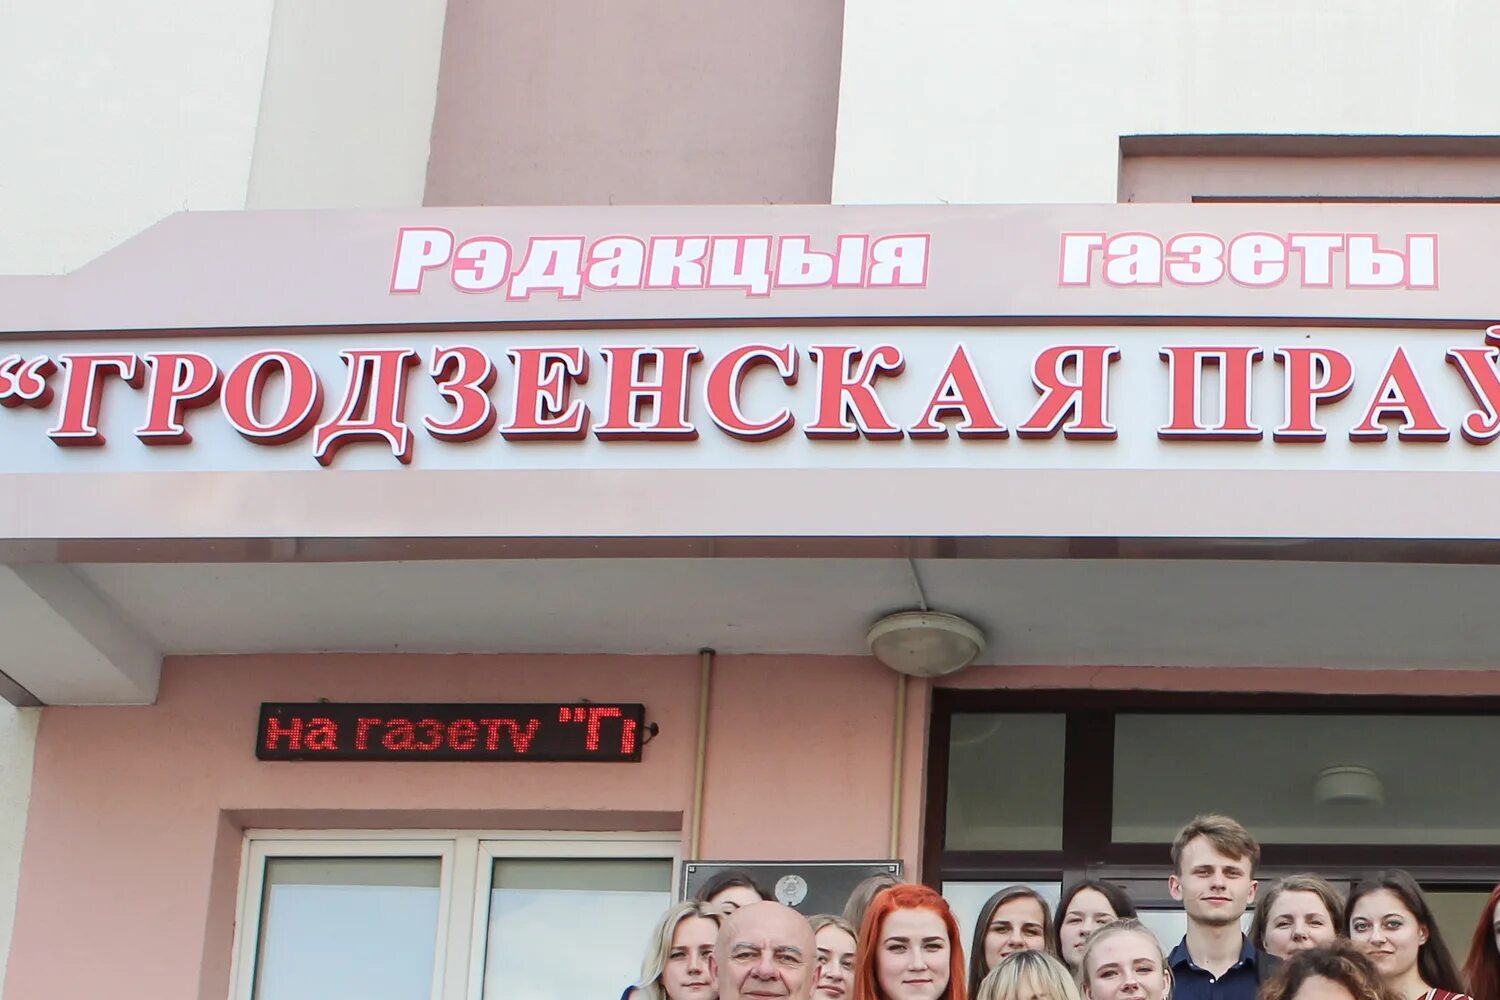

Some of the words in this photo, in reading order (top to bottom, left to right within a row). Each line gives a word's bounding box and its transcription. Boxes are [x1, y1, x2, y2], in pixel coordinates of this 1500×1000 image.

[390, 226, 931, 301] Рэдакцыя
[1058, 231, 1440, 289] газеты
[266, 717, 338, 750] на
